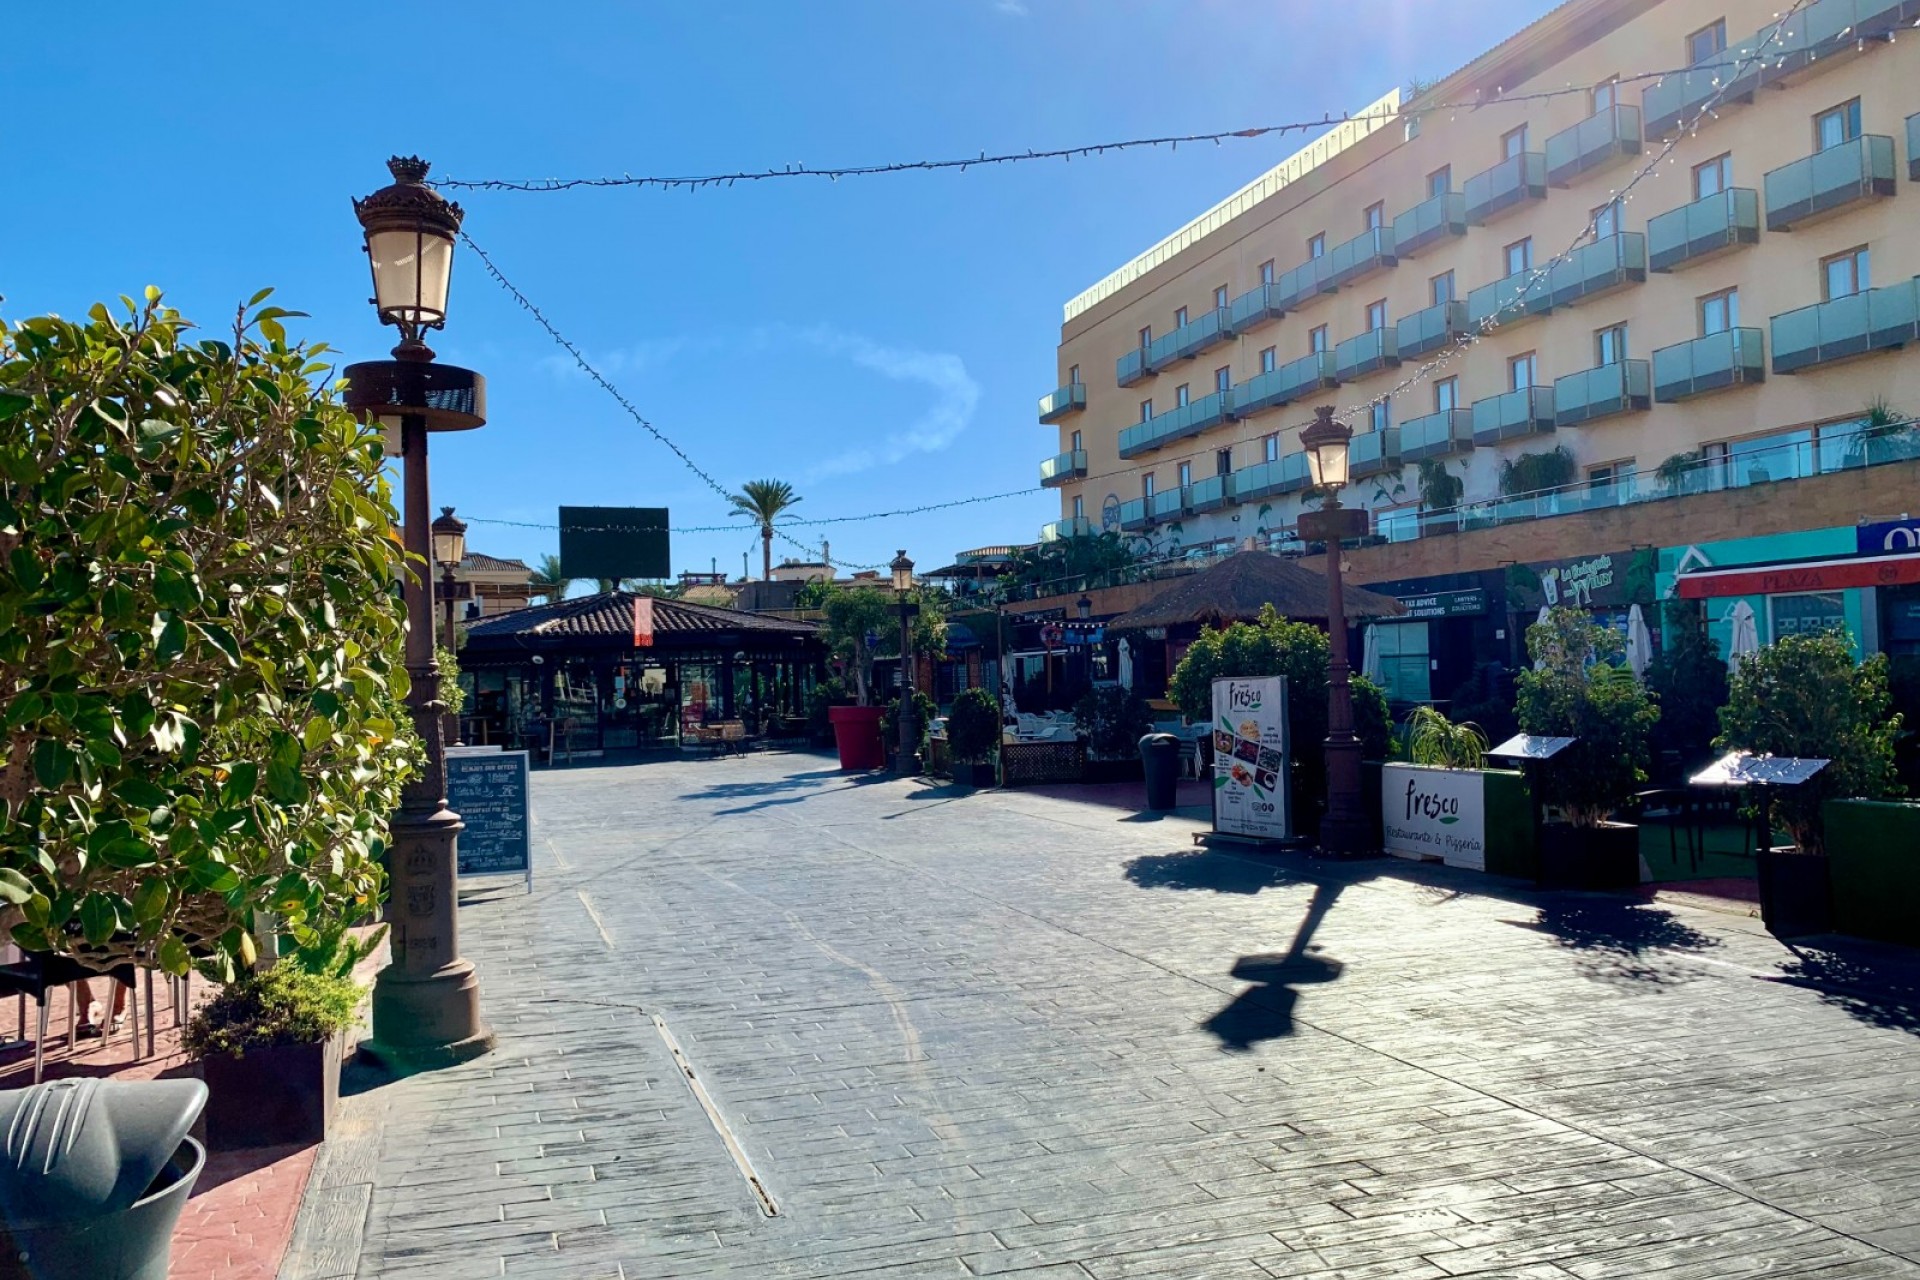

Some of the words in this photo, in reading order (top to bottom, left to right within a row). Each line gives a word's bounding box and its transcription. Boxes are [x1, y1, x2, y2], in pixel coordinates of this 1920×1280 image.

[1763, 571, 1824, 590] PLAZA
[1416, 597, 1437, 607] ADVICE
[1414, 607, 1445, 617] SOLUTIONS
[1229, 681, 1261, 710] fresco
[1405, 779, 1459, 820] fresco
[1386, 825, 1432, 843] Restaurante
[1434, 833, 1441, 845] &
